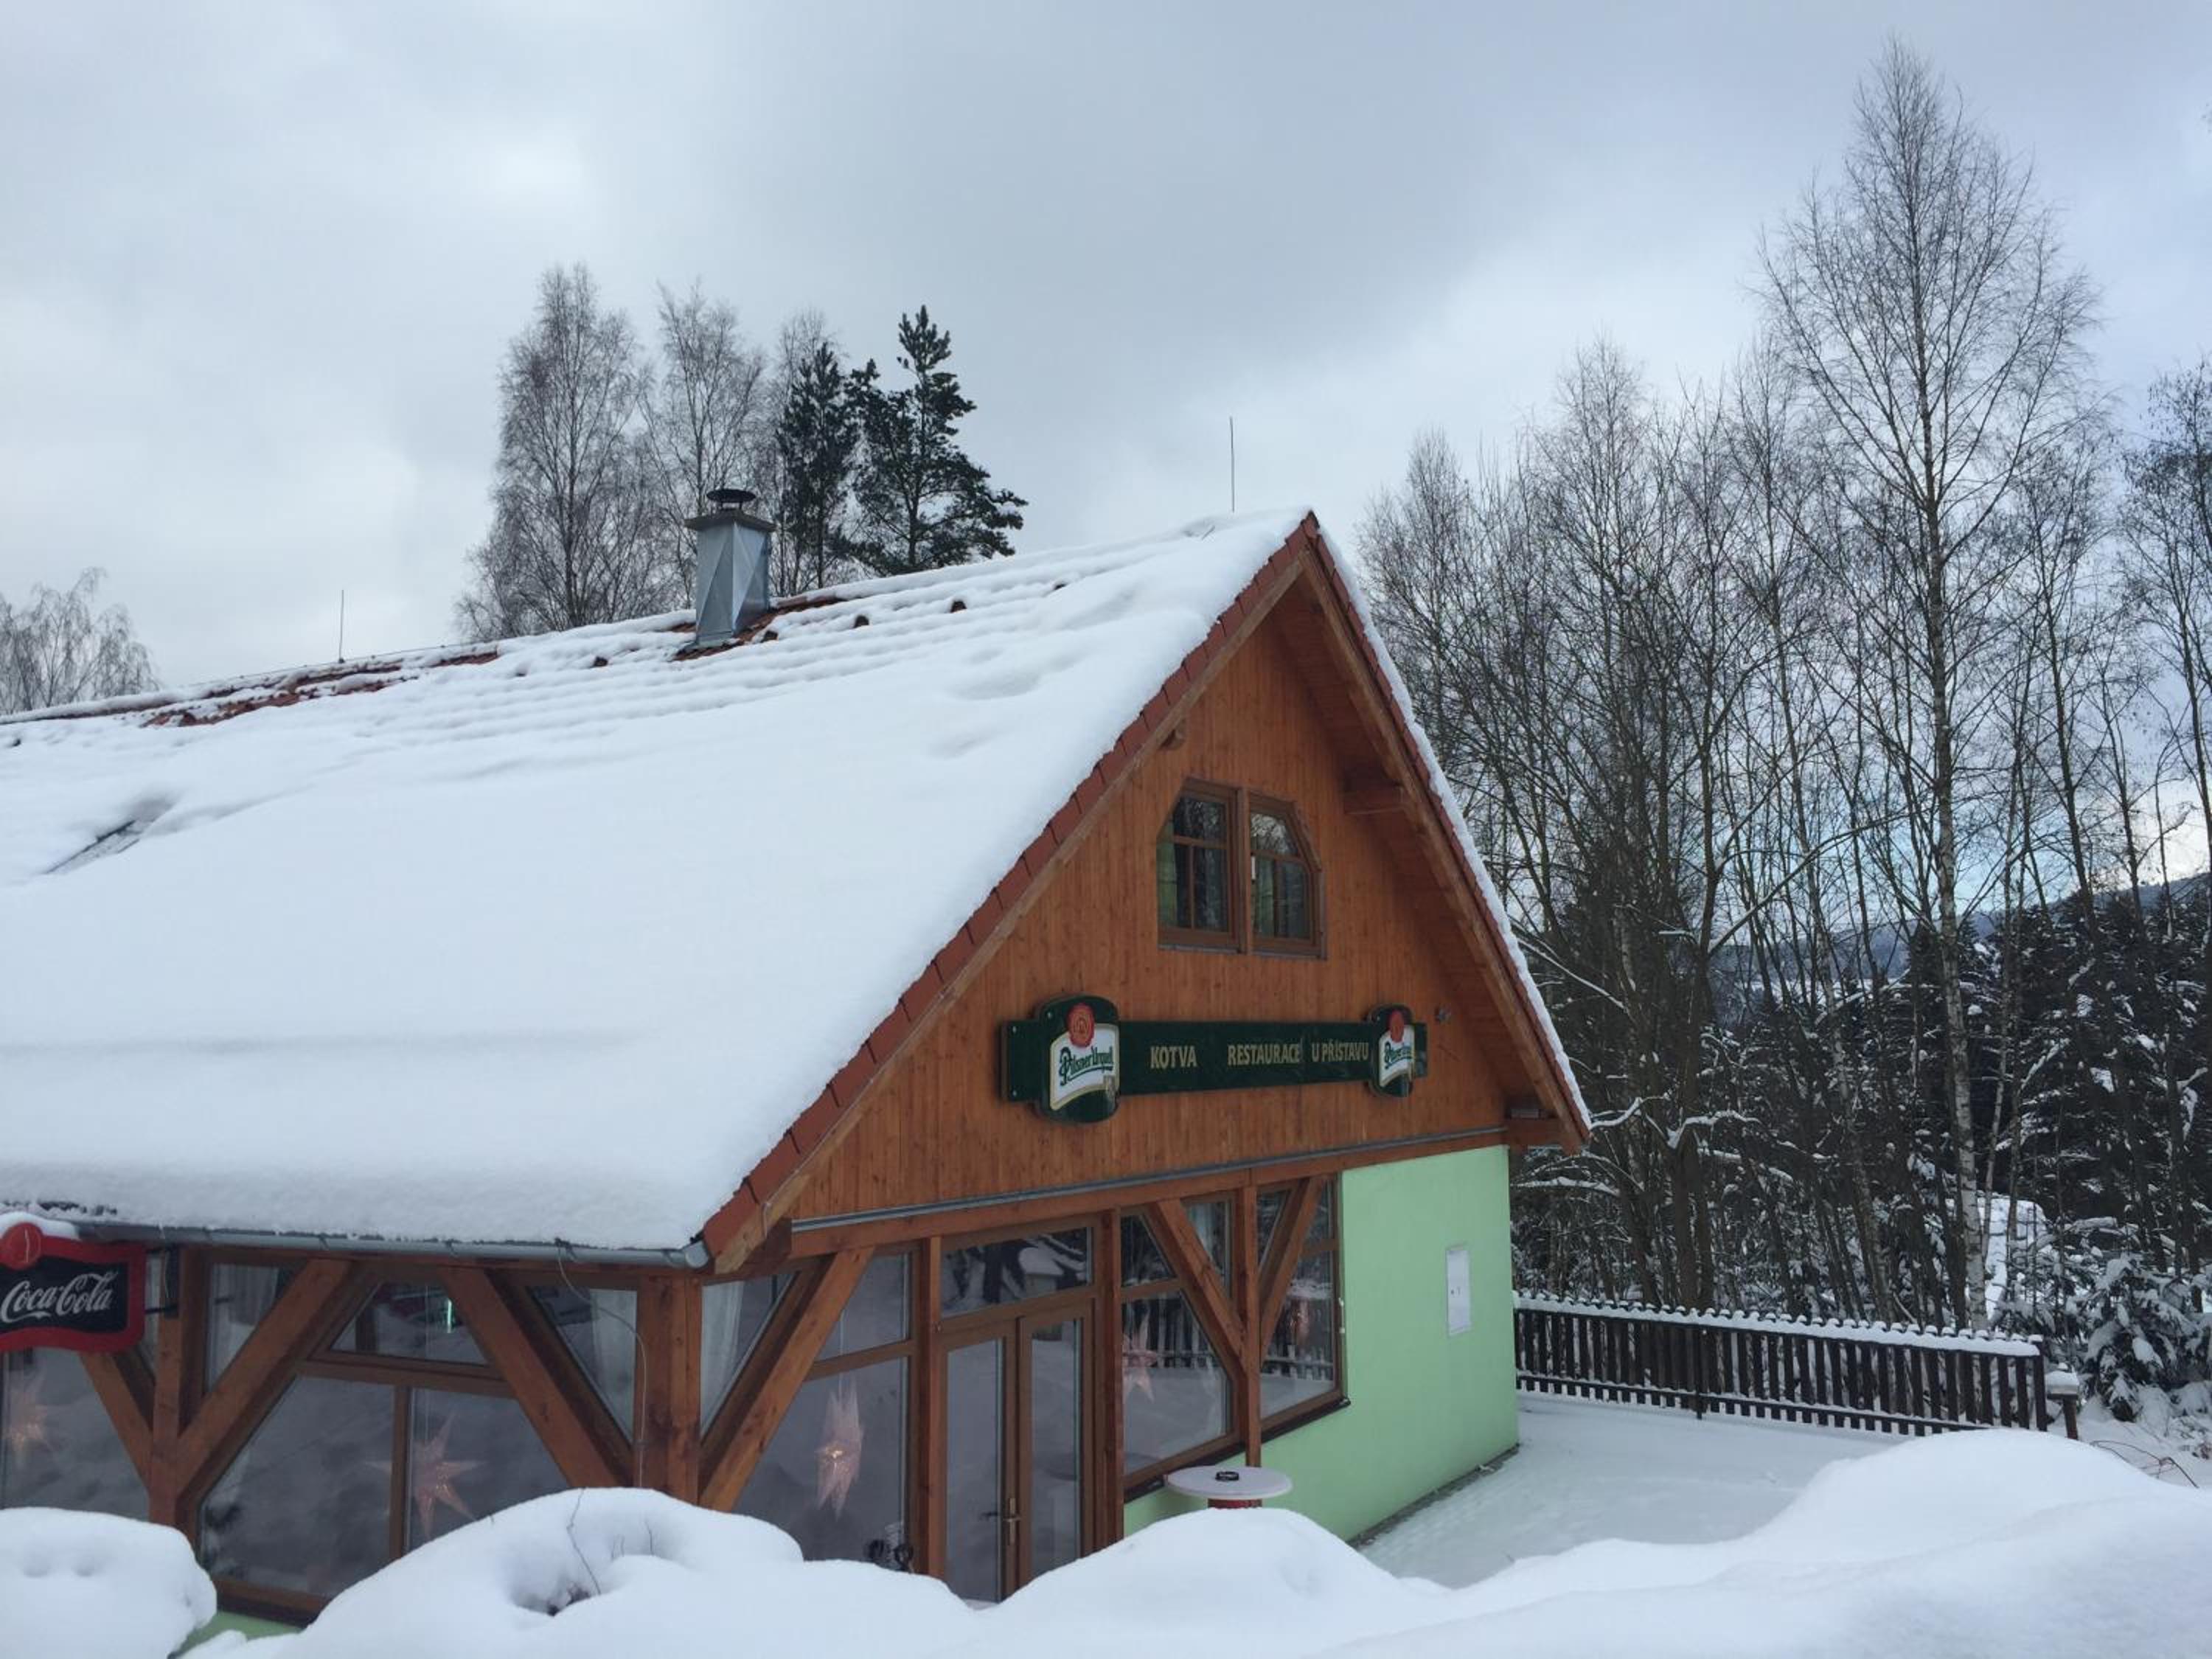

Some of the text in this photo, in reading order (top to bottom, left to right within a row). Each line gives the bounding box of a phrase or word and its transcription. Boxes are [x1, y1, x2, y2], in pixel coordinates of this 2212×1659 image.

[1150, 1046, 1197, 1068] KOTVA
[1227, 1043, 1300, 1066] RESTAURACE
[1312, 1043, 1320, 1062] U
[1, 1271, 118, 1323] Coca-Cola
